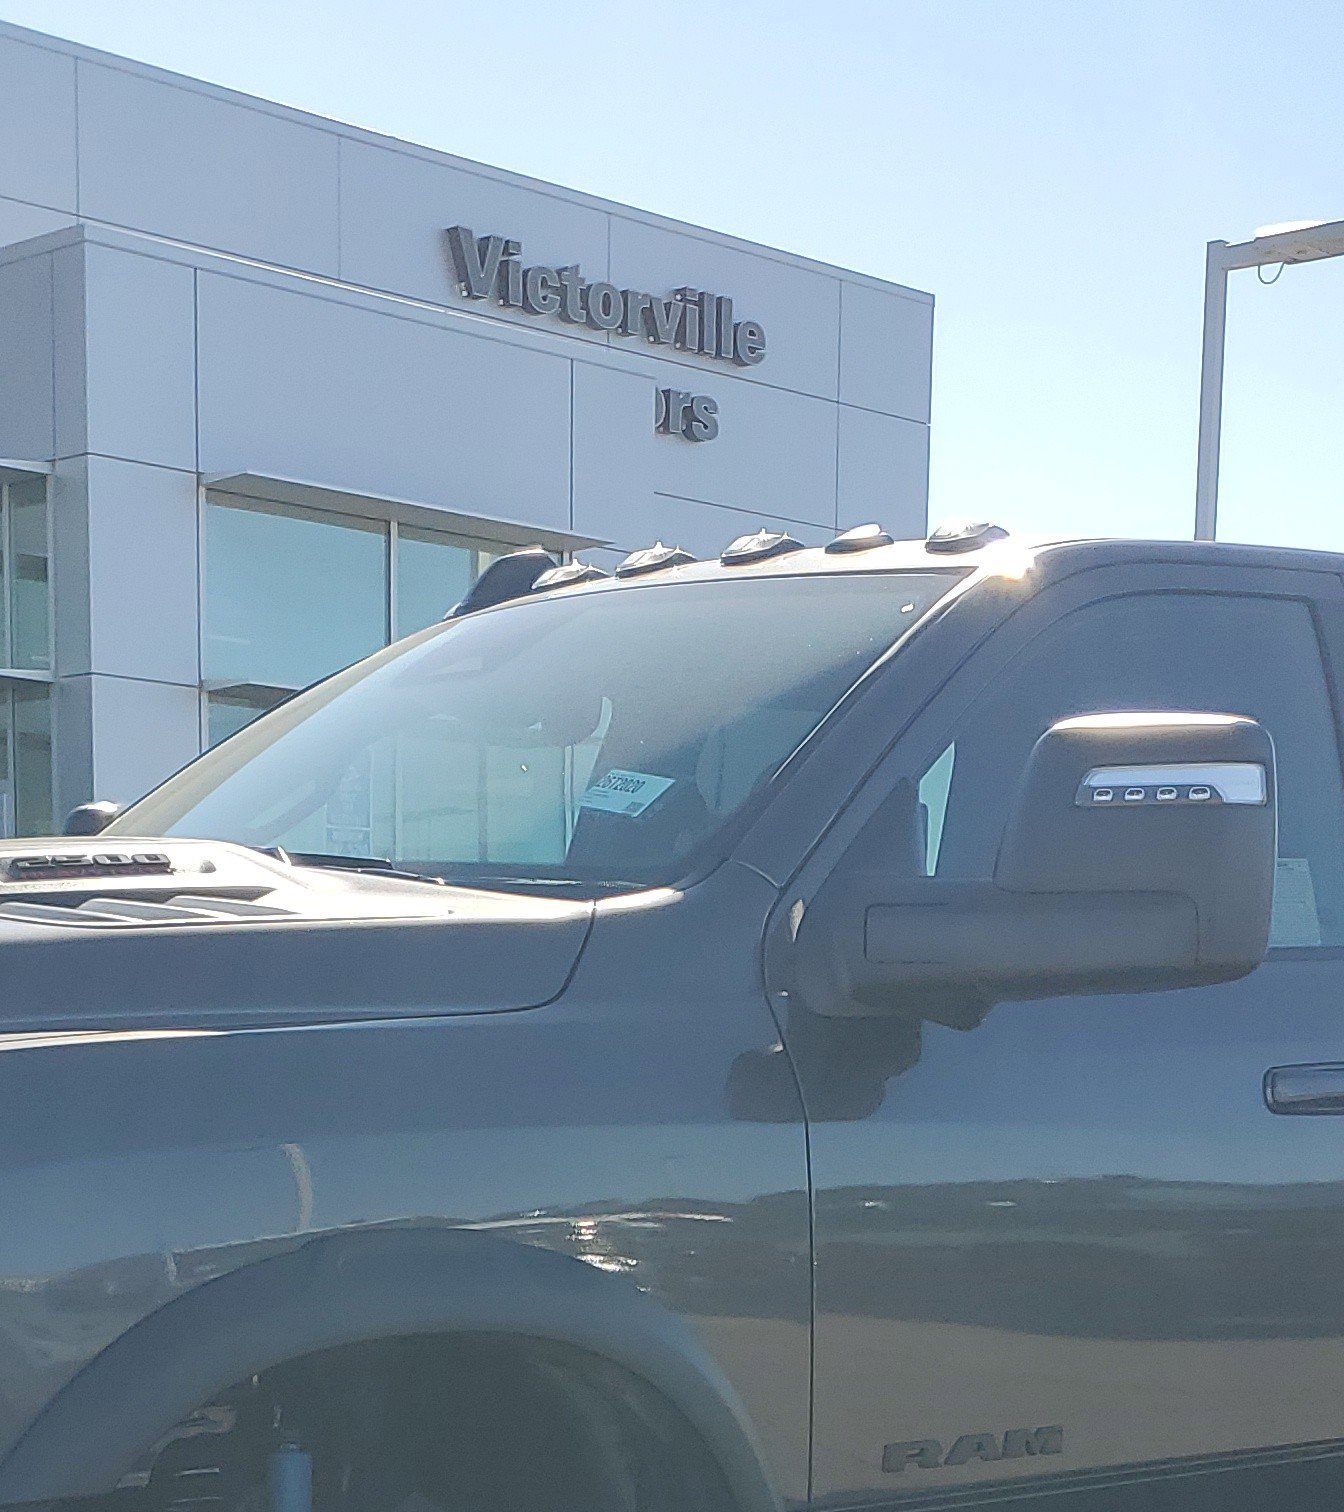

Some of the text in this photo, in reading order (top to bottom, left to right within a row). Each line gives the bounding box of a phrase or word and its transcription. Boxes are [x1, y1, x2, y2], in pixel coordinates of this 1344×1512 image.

[446, 226, 767, 366] Victorville
[9, 853, 173, 872] 2500
[881, 1425, 1064, 1473] RAM
